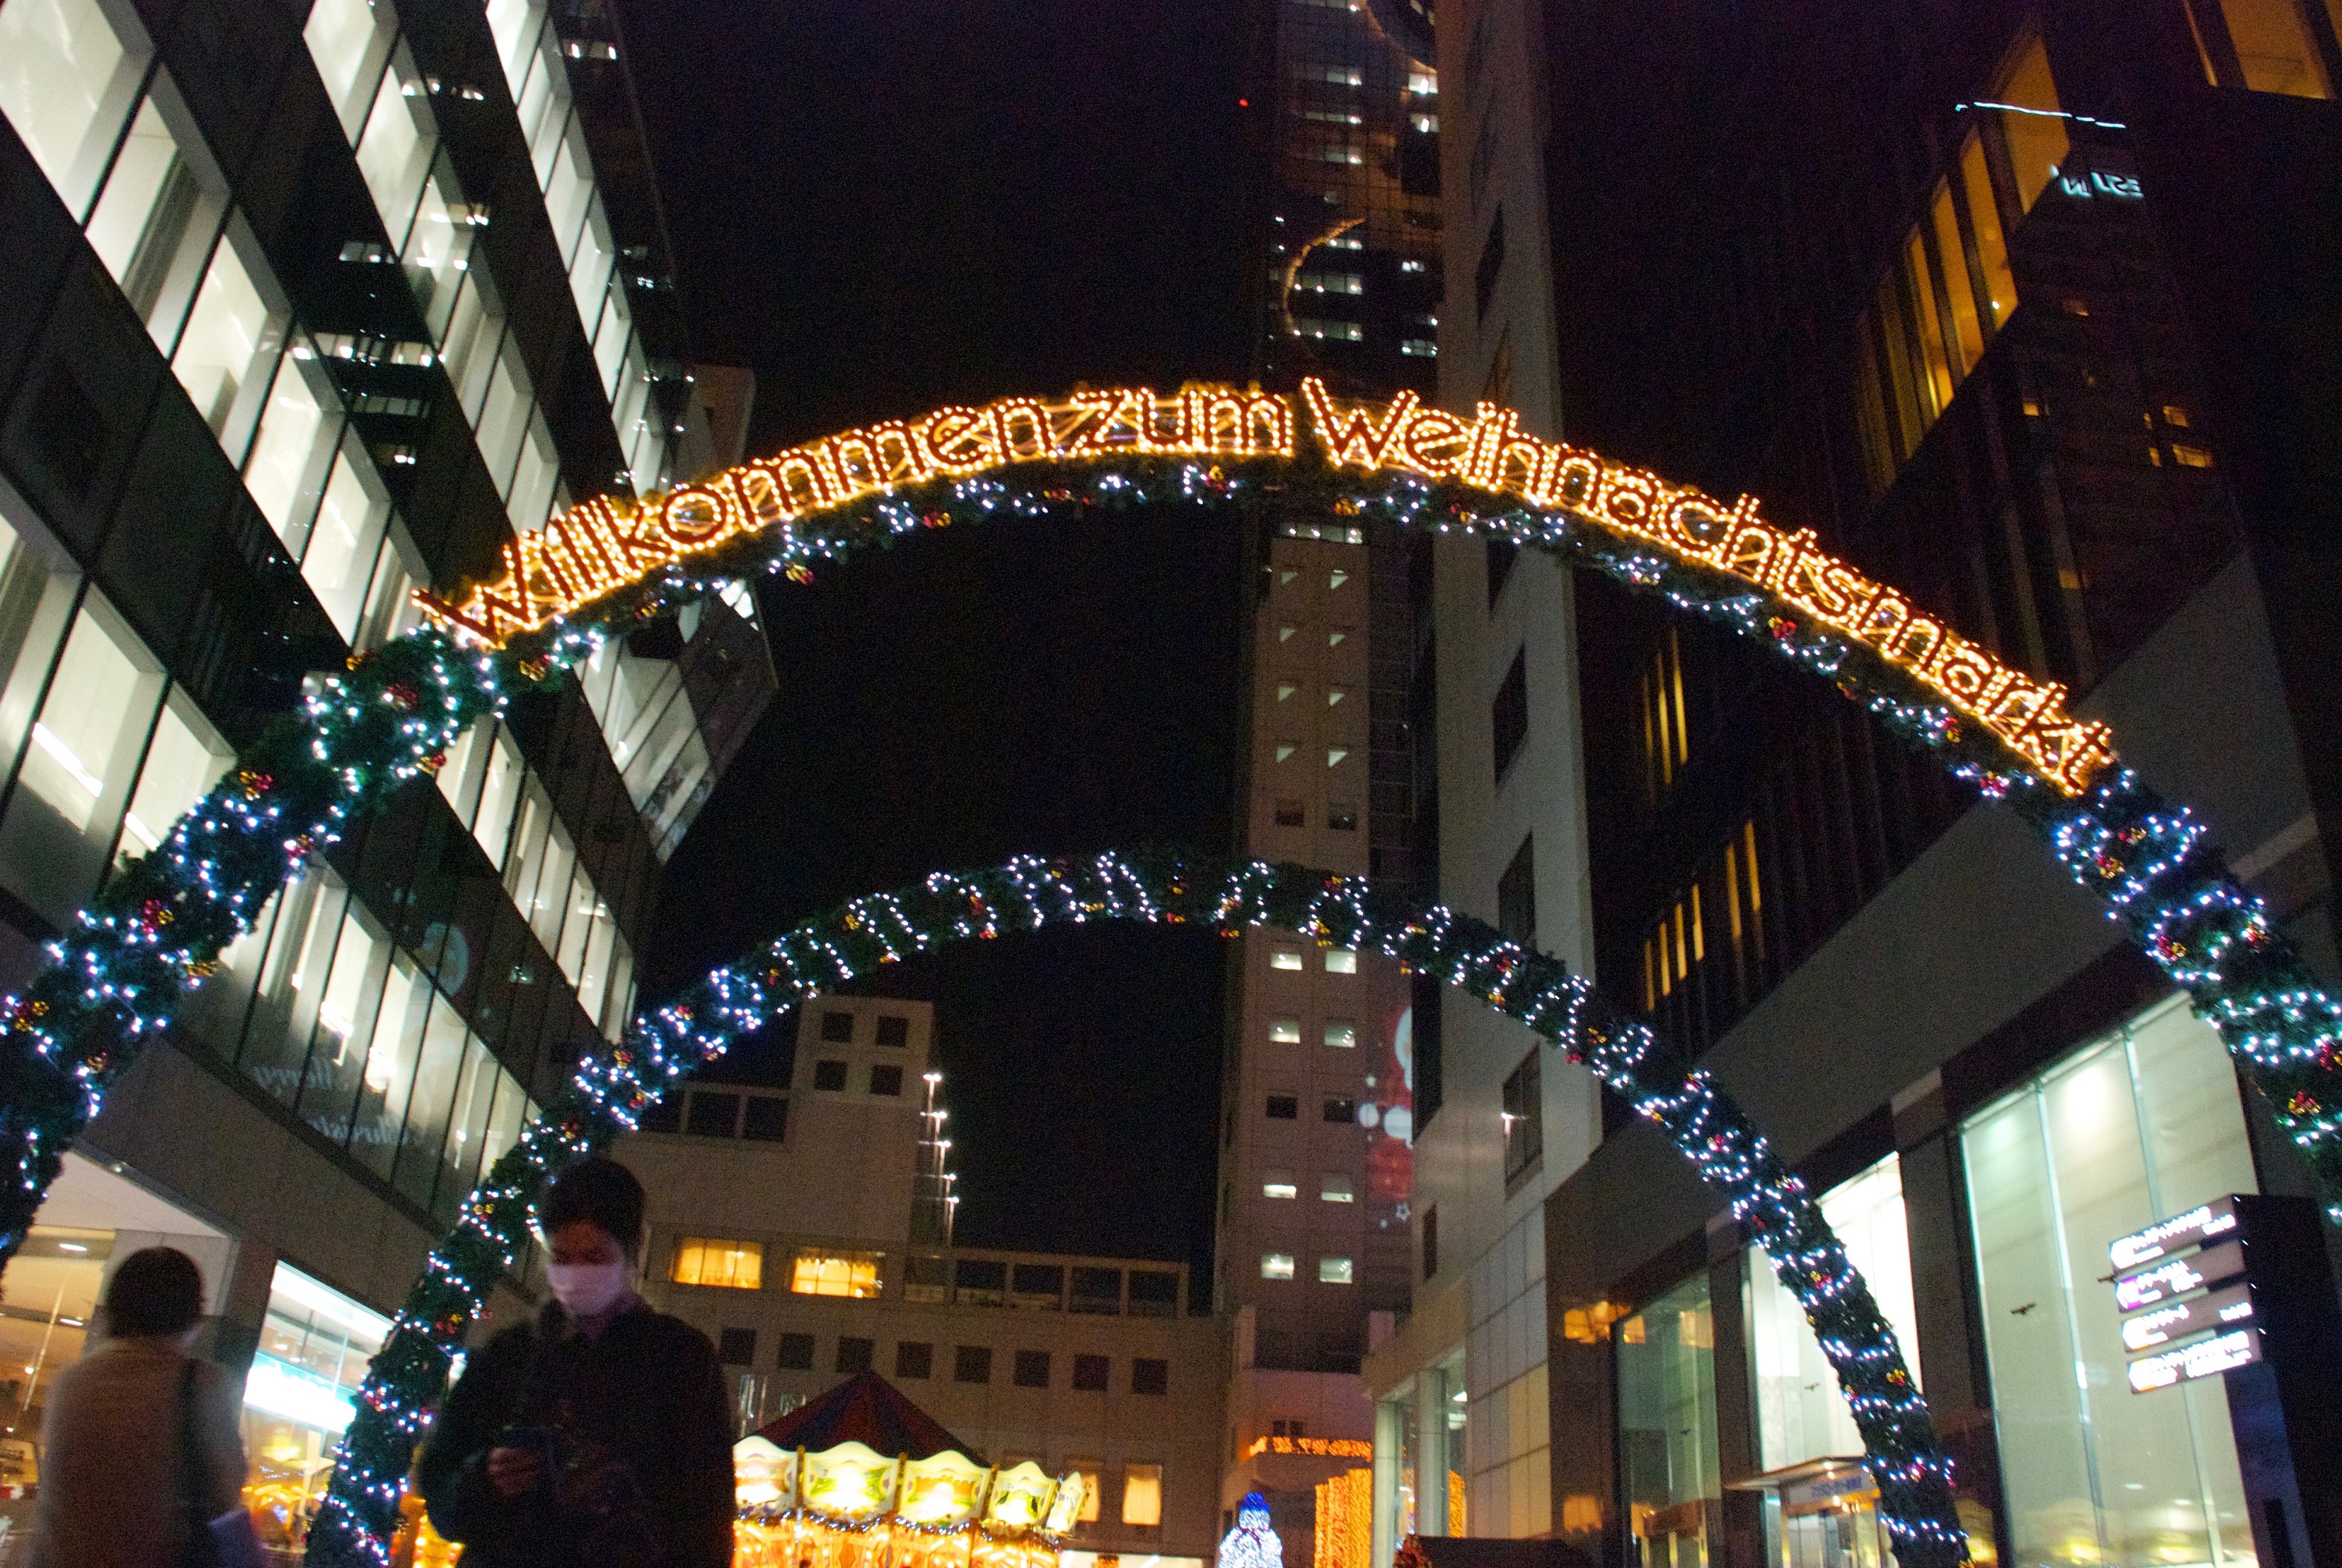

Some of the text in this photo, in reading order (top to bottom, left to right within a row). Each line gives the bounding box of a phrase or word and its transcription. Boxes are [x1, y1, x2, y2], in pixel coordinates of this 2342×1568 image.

[410, 376, 2113, 797] Willkommen zum Weihnachtsmarkt
